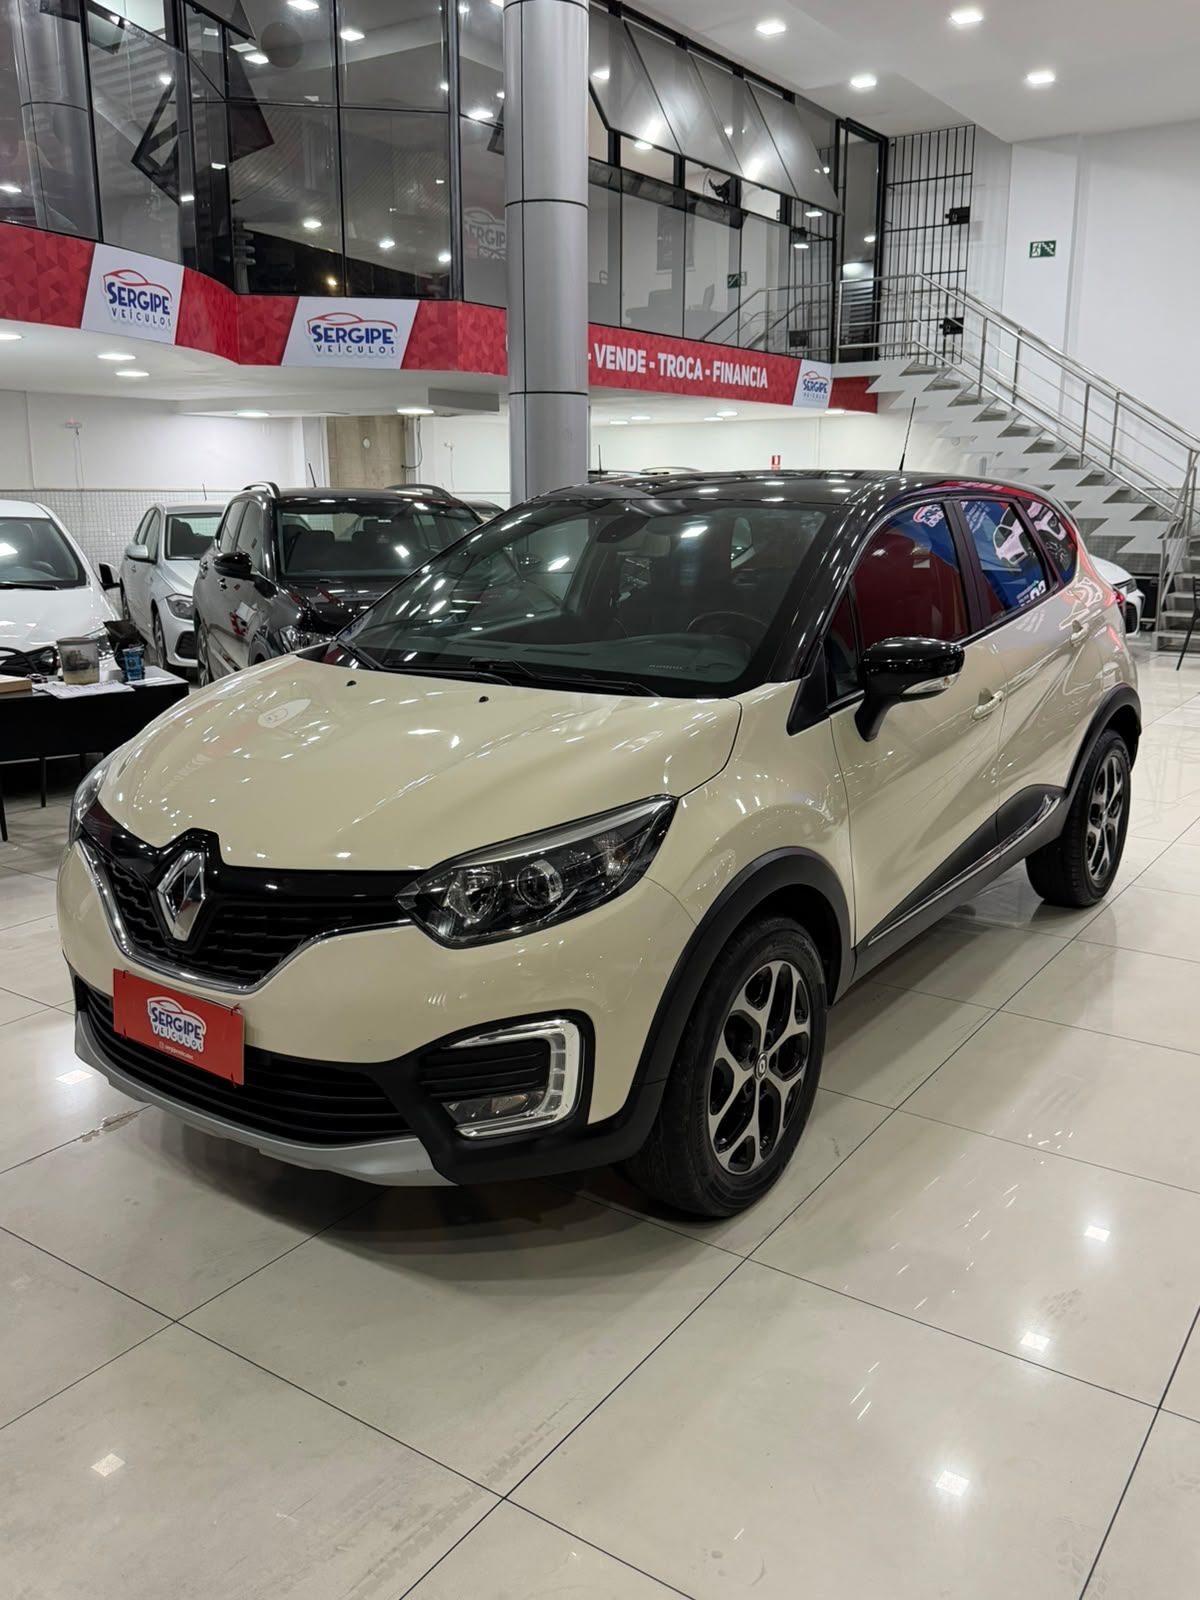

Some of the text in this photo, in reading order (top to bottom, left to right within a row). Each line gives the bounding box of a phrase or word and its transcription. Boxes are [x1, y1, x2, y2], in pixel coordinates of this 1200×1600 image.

[107, 282, 170, 315] SERGIPE
[311, 324, 394, 344] SERGIPE
[316, 344, 395, 354] VEÍCULOS
[594, 343, 647, 374] VENDE
[657, 352, 703, 381] TROCA
[712, 360, 768, 389] FINANCIA
[151, 1006, 202, 1041] SERGIPE
